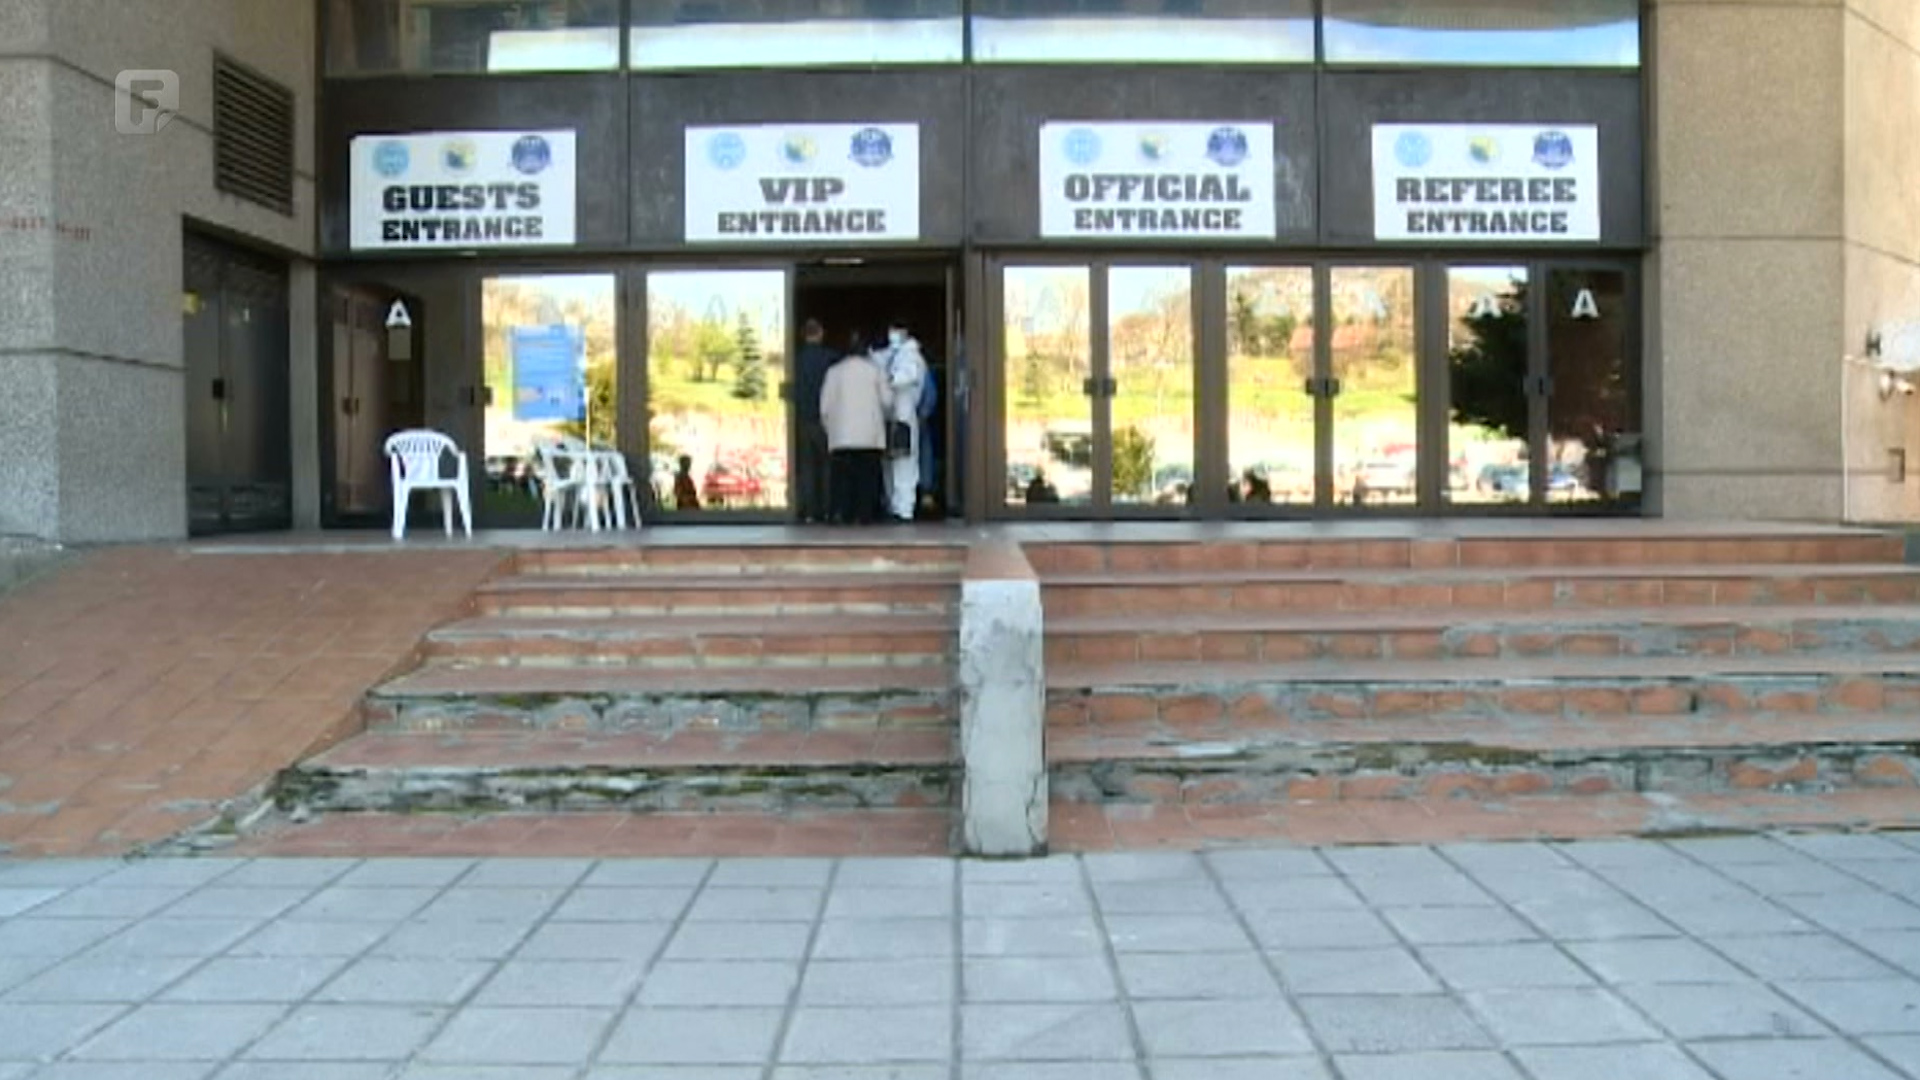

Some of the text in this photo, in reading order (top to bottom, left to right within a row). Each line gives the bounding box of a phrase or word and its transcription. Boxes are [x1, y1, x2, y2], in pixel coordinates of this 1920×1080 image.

[382, 183, 541, 213] GUESTS
[759, 178, 844, 203] VIP
[1064, 174, 1250, 202] OFFICIAL
[1396, 177, 1577, 202] REFEREE
[381, 216, 543, 241] ENTRANCE
[717, 209, 886, 233] ENTRANCE
[1074, 208, 1242, 230] ENTRANCE
[1406, 211, 1568, 233] ENTRANCE
[386, 299, 412, 326] A
[1571, 288, 1599, 318] A
